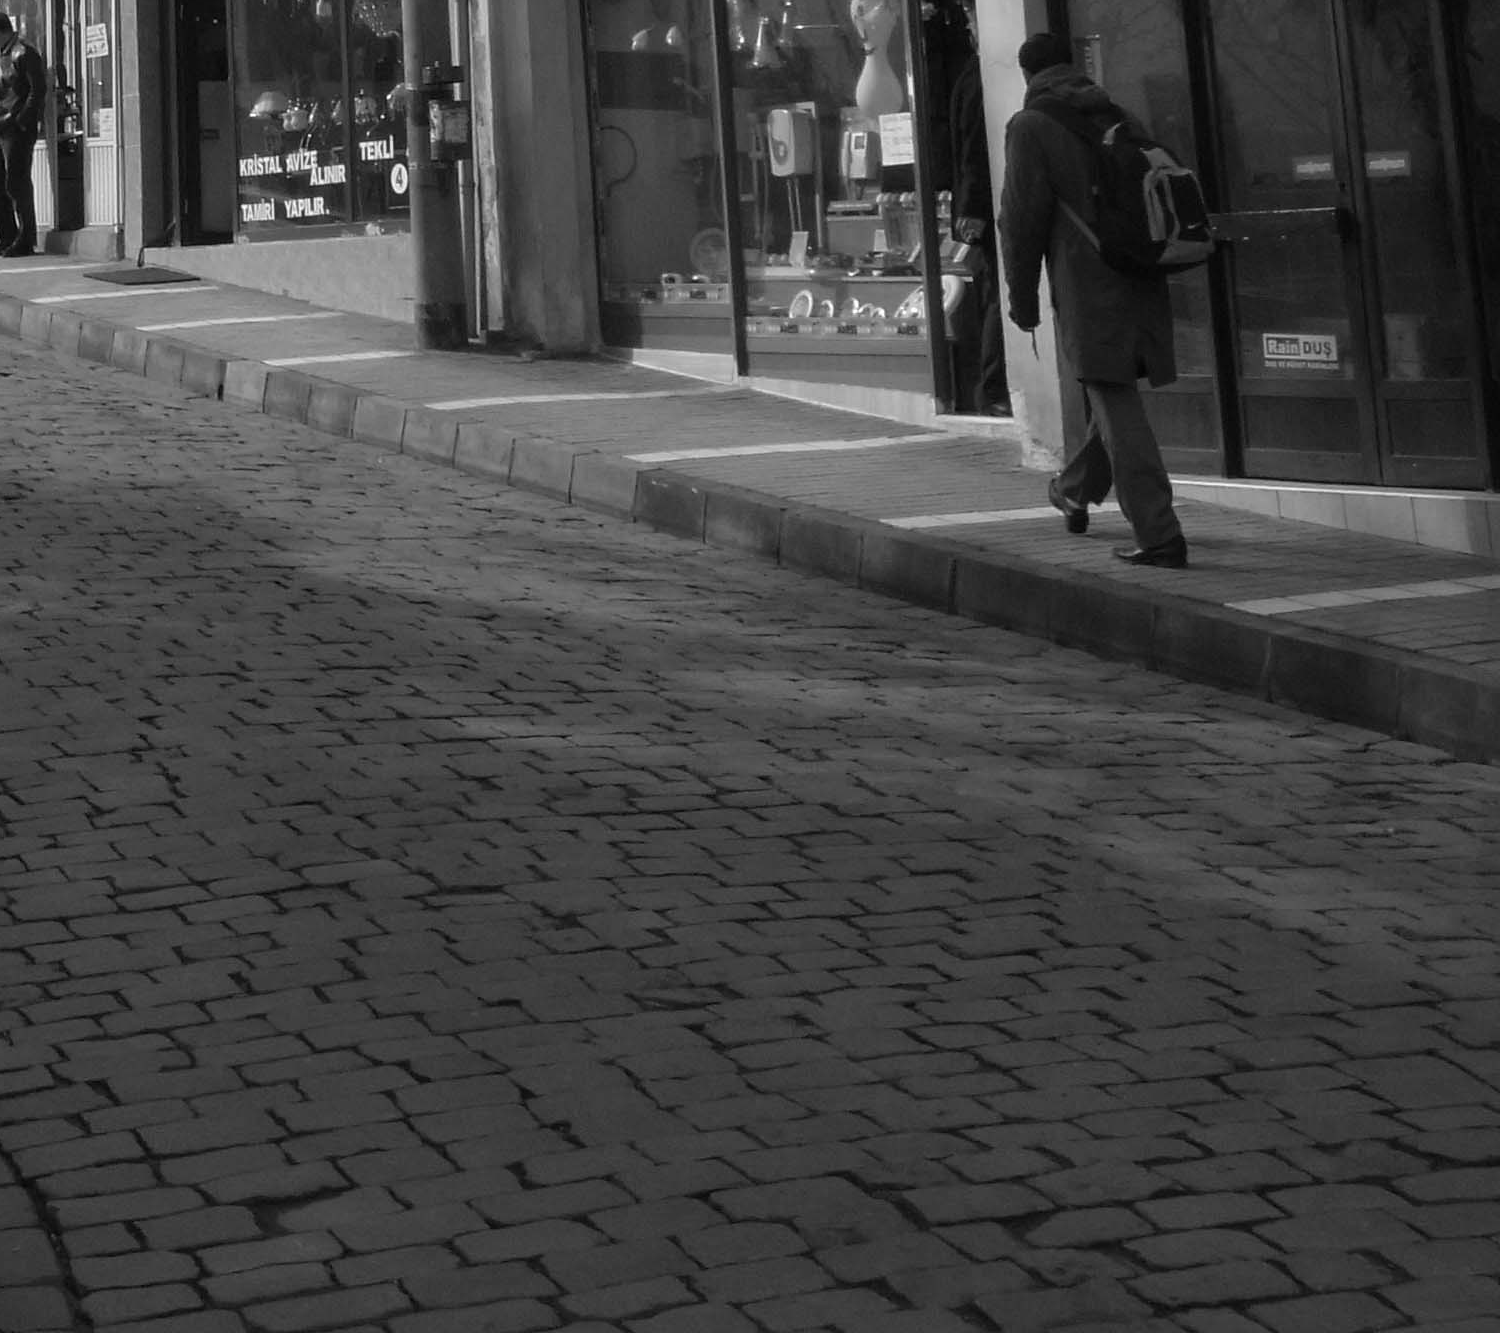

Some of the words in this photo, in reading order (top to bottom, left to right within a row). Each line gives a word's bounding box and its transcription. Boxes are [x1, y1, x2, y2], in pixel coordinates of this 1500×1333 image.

[239, 153, 283, 177] KRİSTAL
[286, 148, 318, 173] AVİZE
[310, 165, 346, 186] ALINIR
[241, 198, 275, 221] TAMİRİ
[1303, 341, 1331, 358] DUŞ
